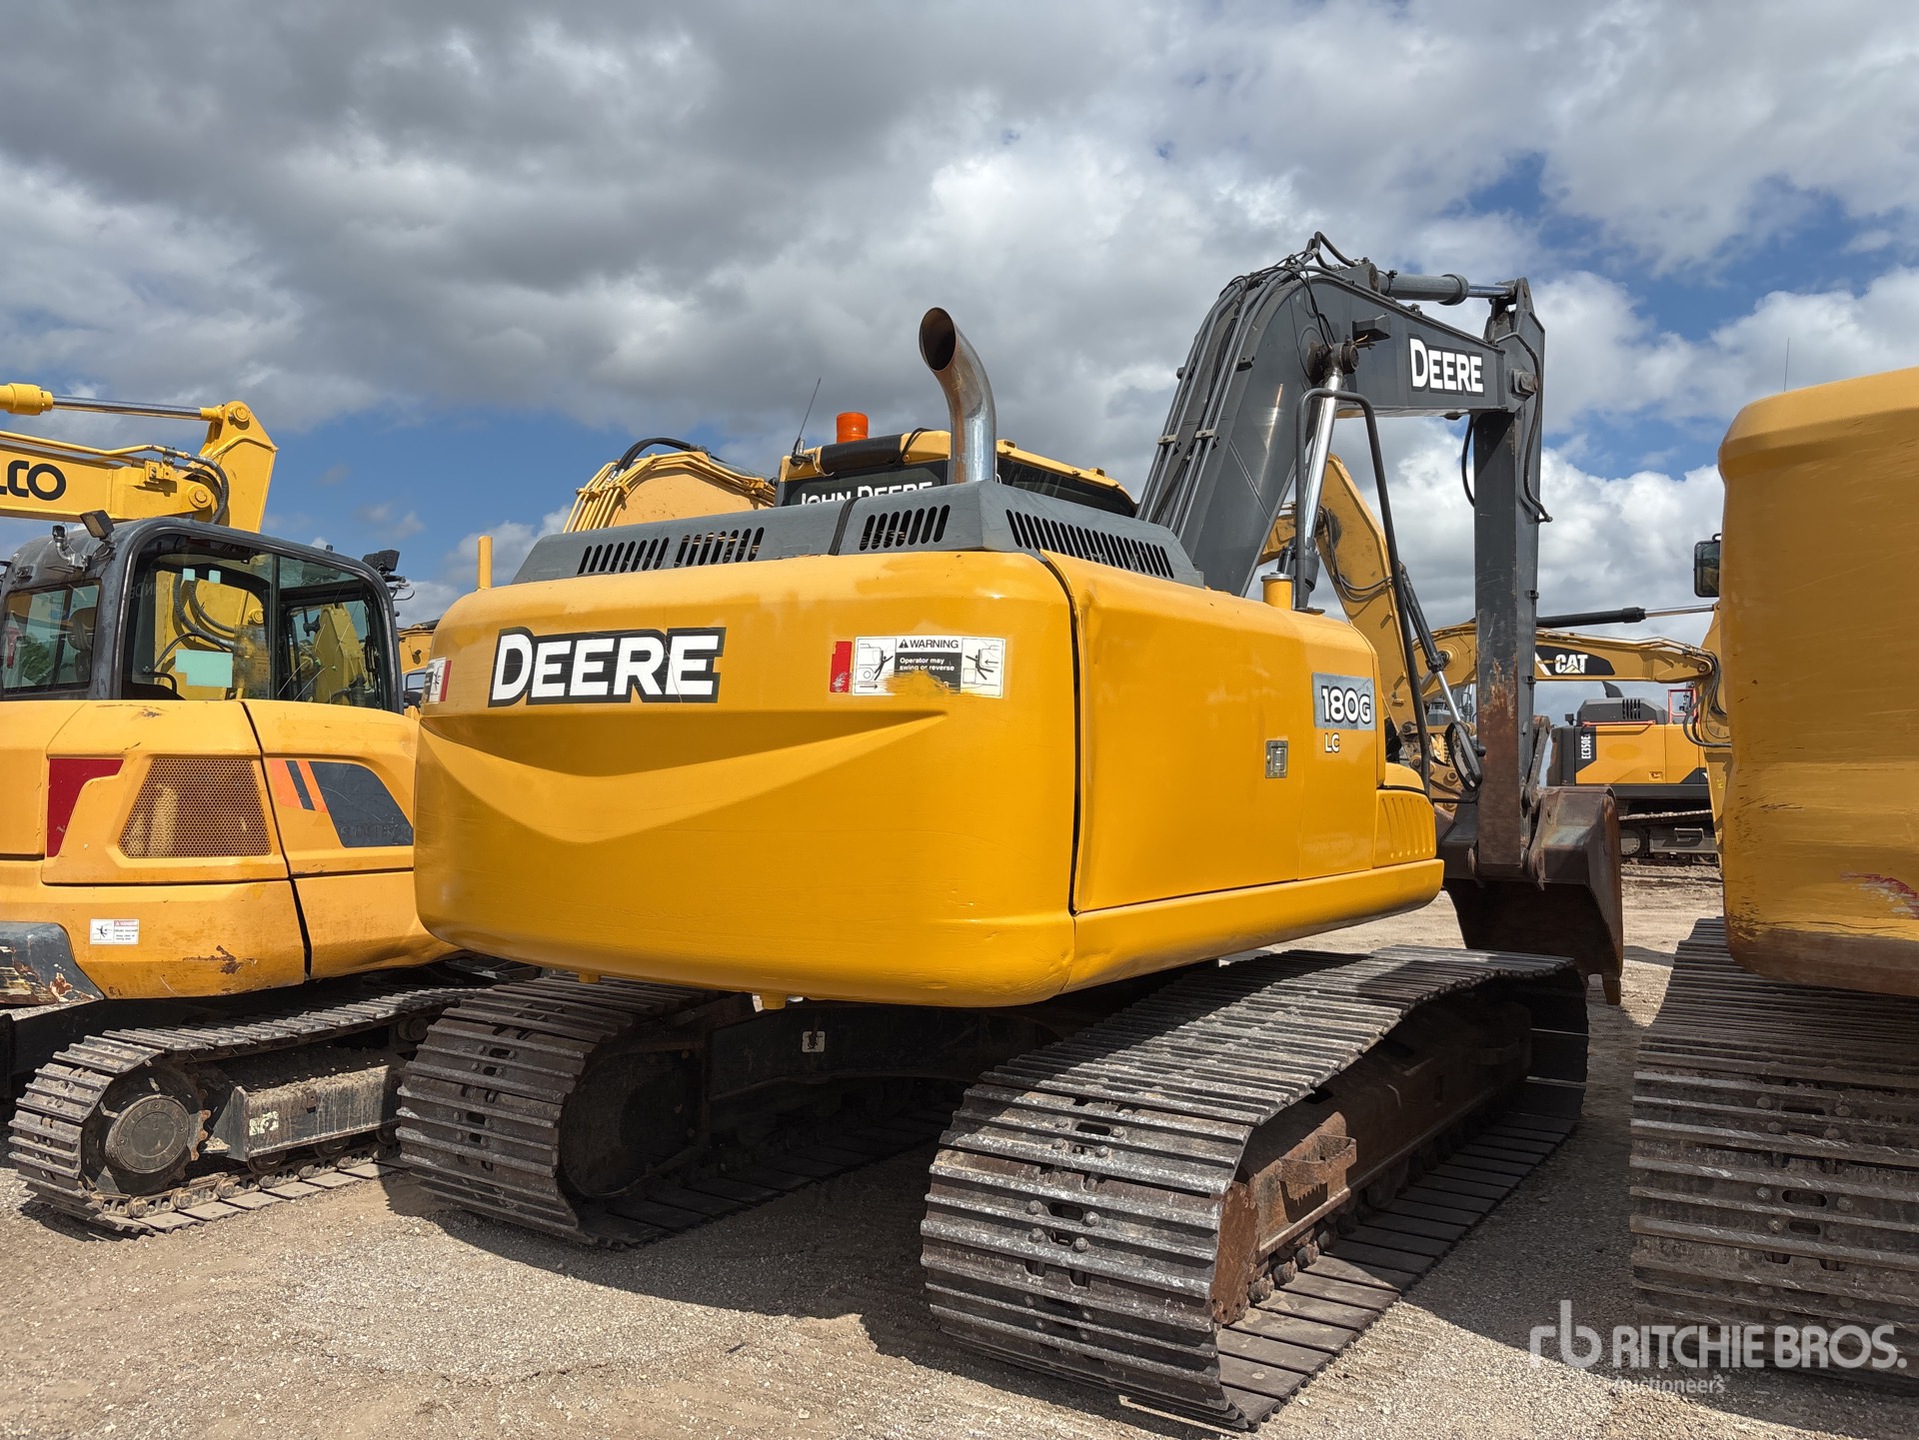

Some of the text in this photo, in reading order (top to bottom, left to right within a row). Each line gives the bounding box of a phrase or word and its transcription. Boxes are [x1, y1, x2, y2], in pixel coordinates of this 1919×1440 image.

[1409, 338, 1484, 393] DEERE
[0, 459, 67, 501] CO
[910, 639, 959, 649] WARNING
[491, 633, 720, 701] DEERE
[899, 657, 929, 665] Operator
[1555, 653, 1589, 674] CAT
[1321, 685, 1372, 725] 180G
[1324, 732, 1340, 753] LC
